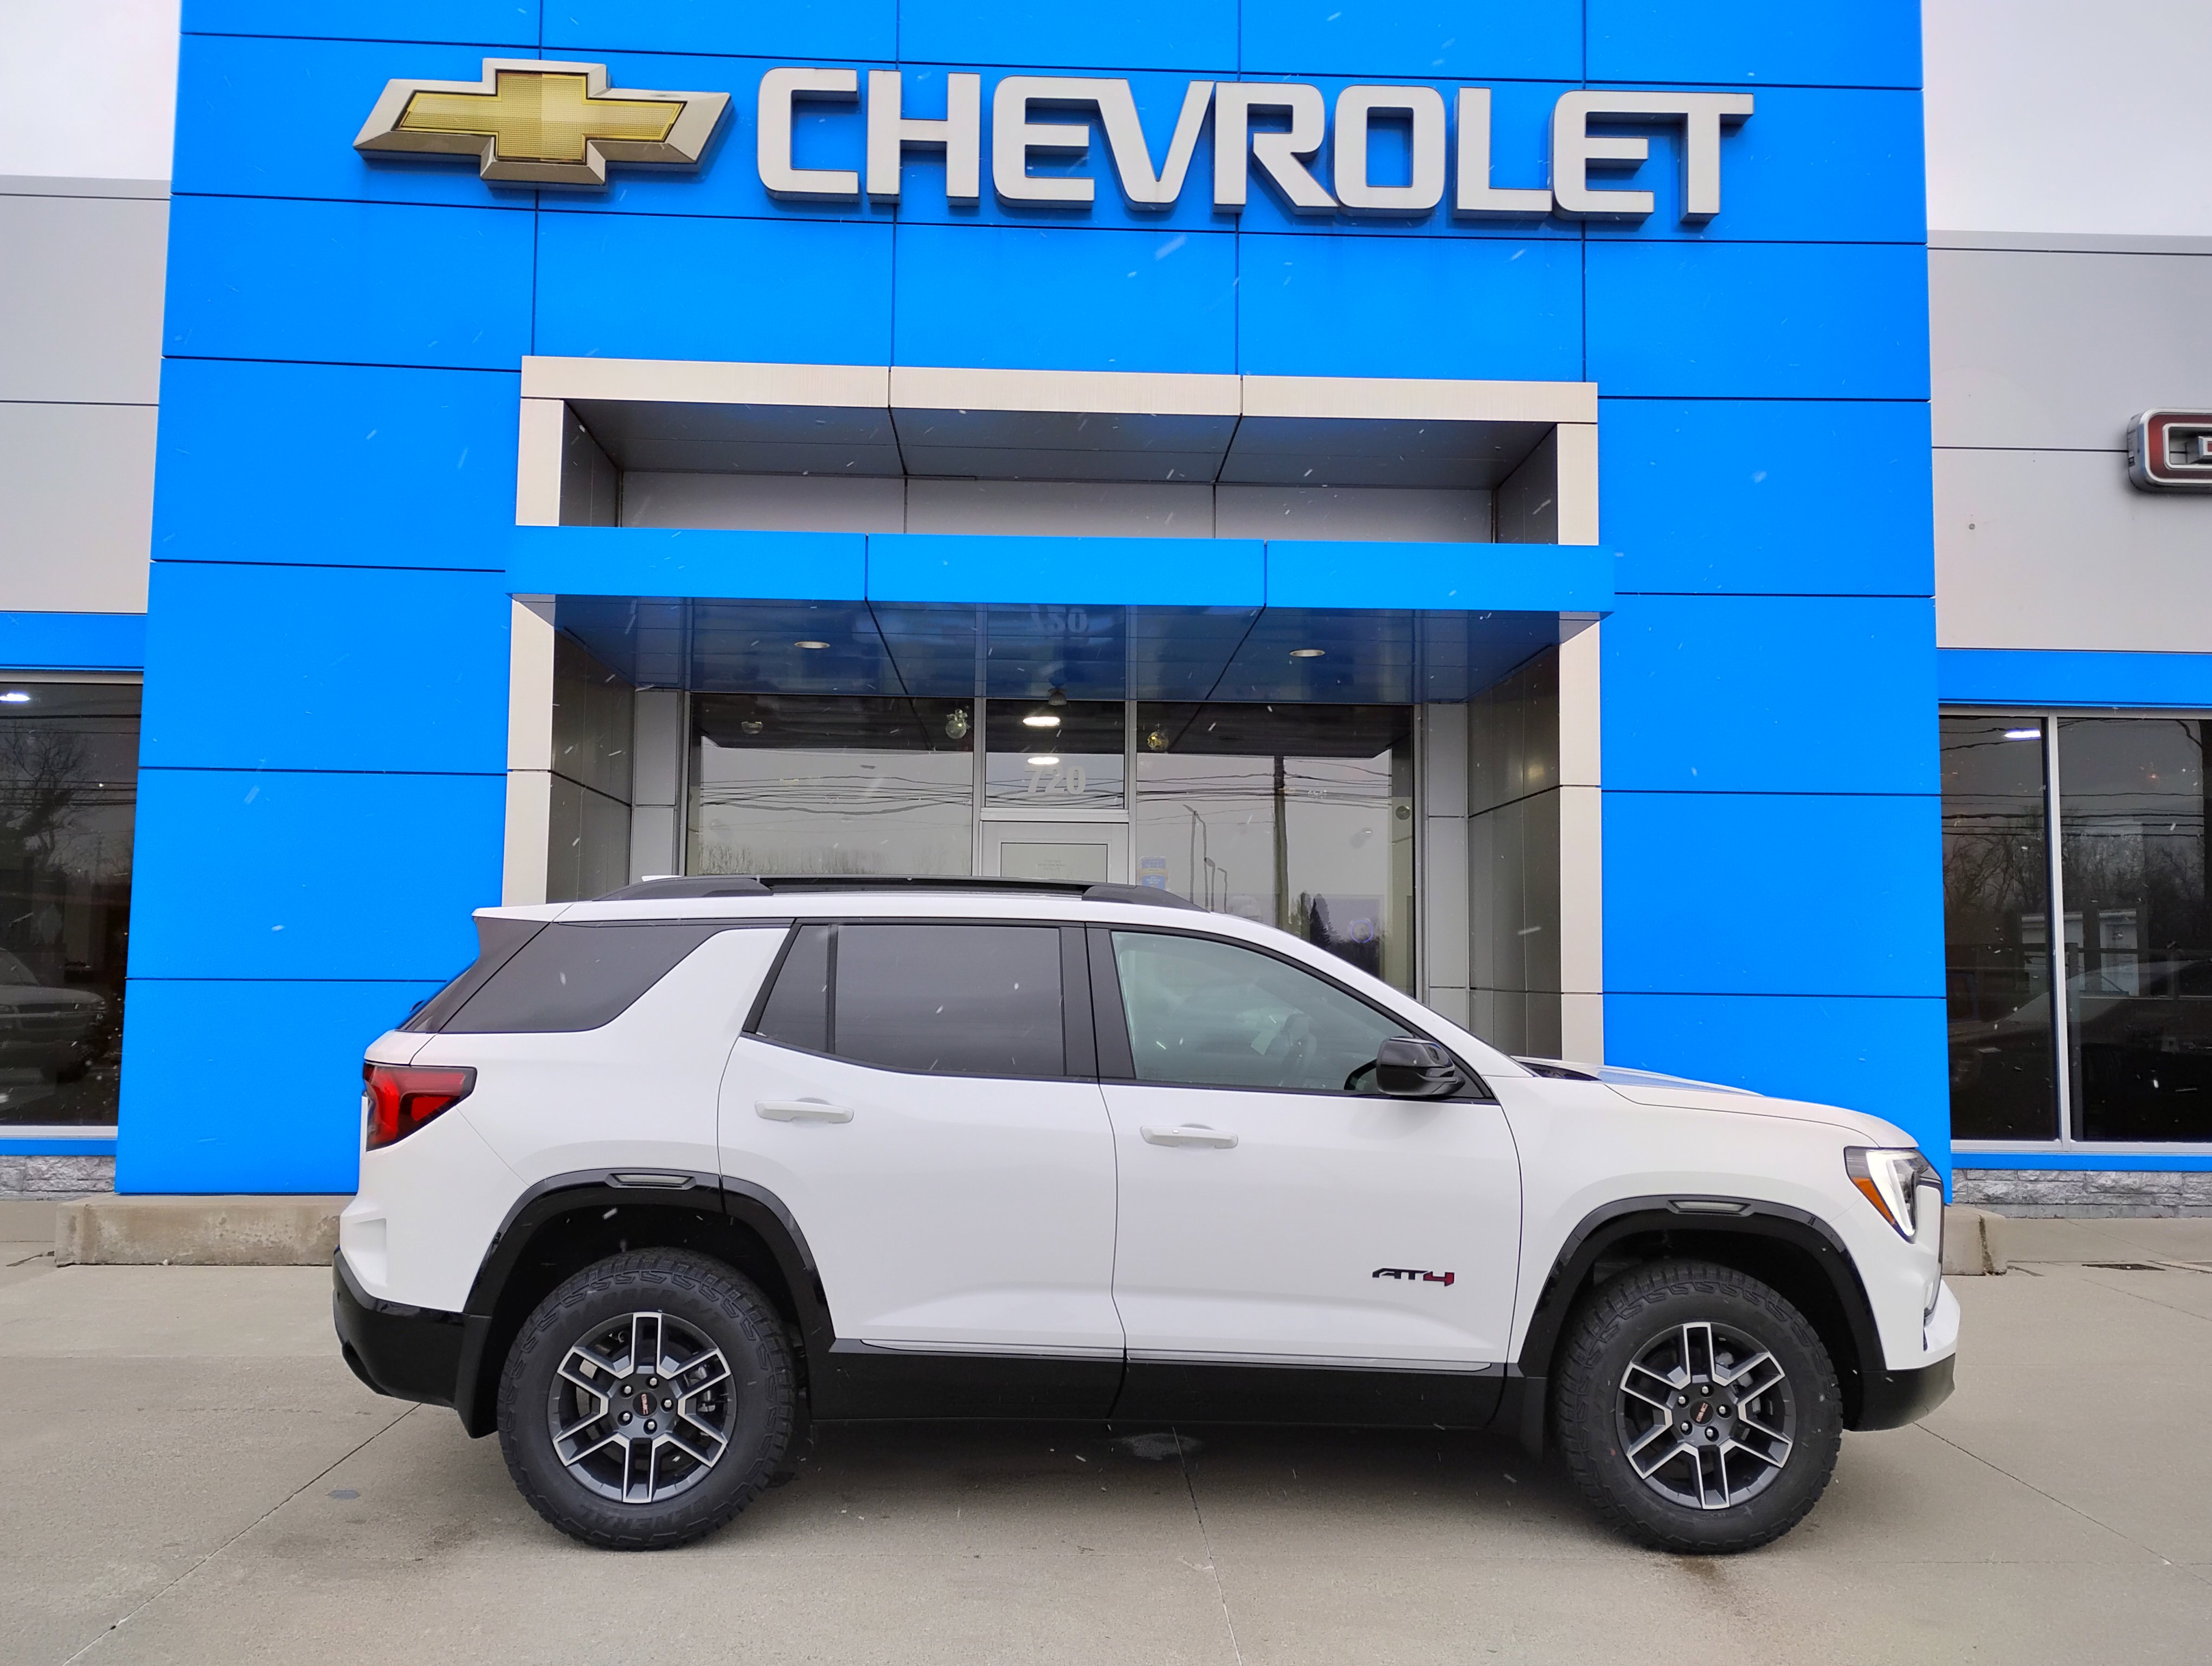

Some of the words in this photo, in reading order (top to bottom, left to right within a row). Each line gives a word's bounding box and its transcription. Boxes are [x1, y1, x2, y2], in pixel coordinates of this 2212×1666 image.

[757, 66, 1755, 222] CHEVROLET
[1024, 765, 1086, 795] 720
[1372, 1267, 1455, 1287] AT4
